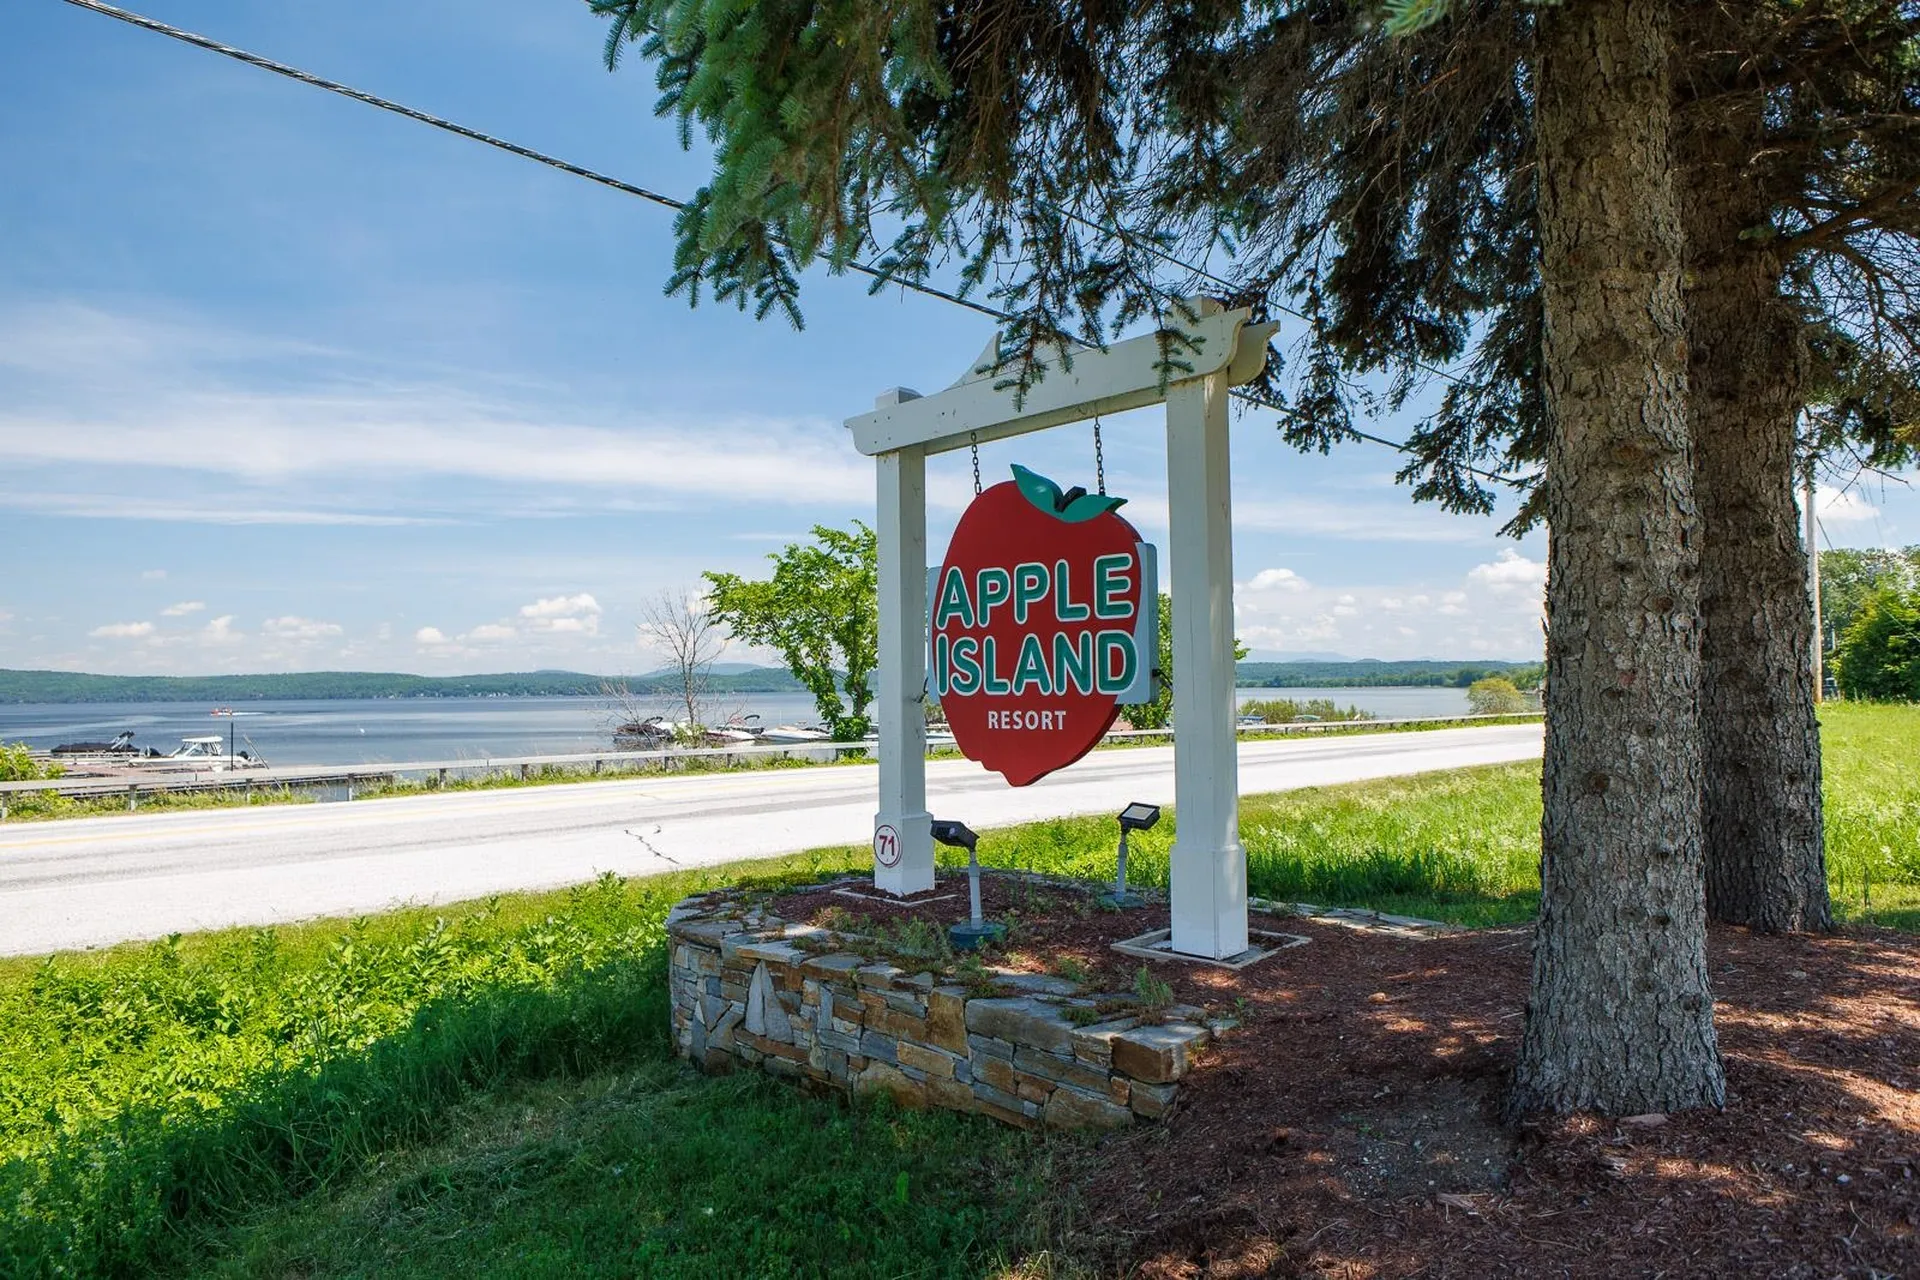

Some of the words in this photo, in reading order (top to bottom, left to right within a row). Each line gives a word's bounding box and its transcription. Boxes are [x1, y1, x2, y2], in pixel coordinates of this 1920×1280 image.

[936, 552, 1135, 630] APPLE
[935, 630, 1139, 696] ISLAND
[988, 710, 1066, 731] RESORT
[879, 834, 895, 856] 71
